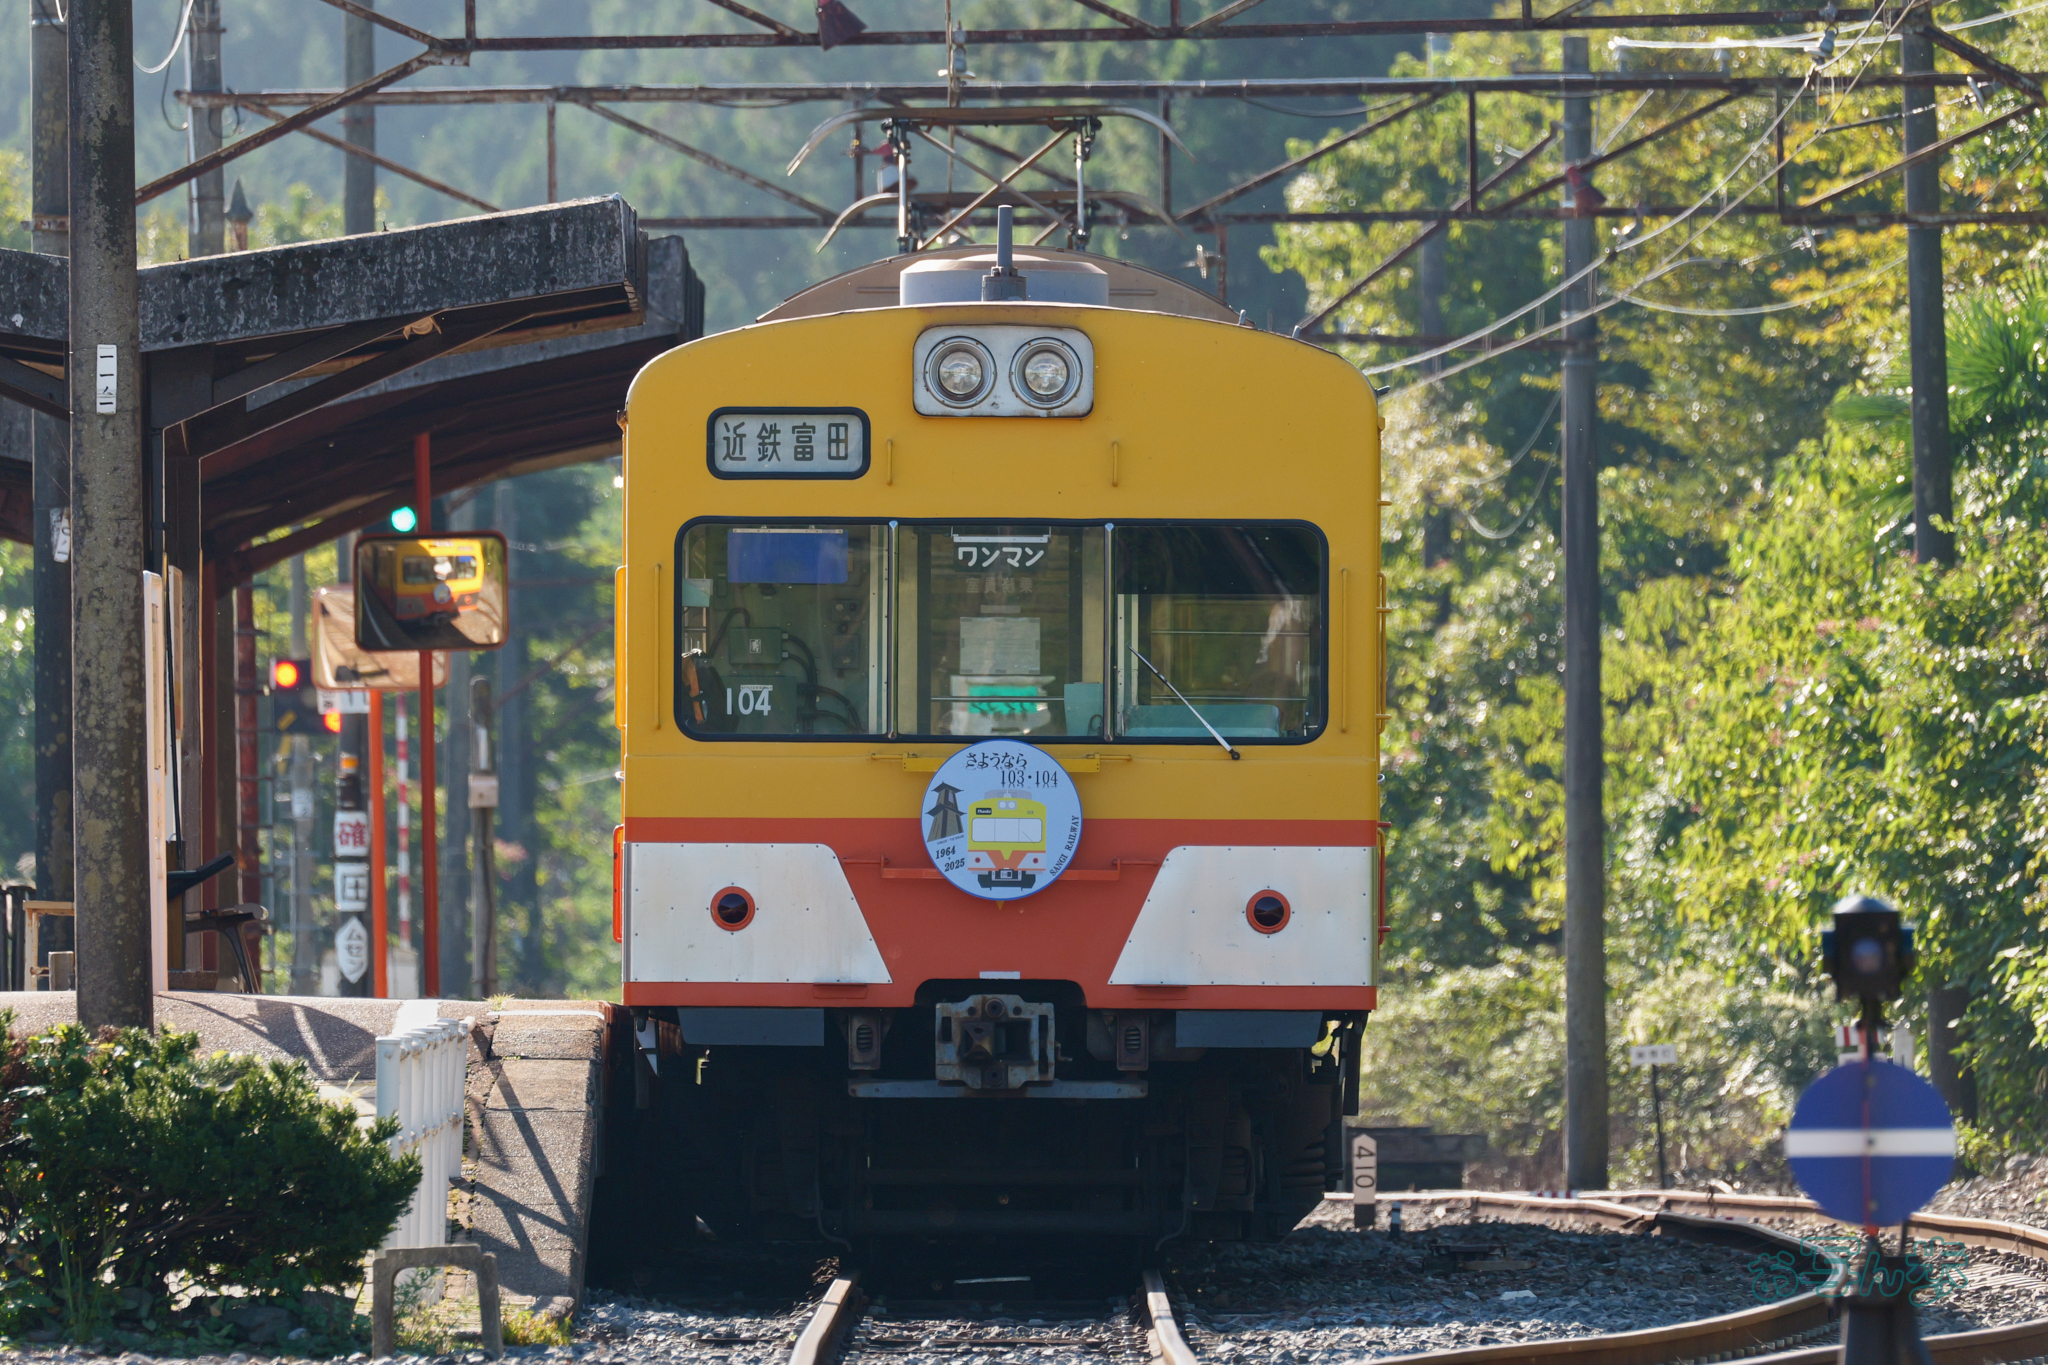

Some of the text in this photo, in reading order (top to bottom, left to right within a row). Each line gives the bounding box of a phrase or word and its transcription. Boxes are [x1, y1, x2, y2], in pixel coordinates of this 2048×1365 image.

[723, 422, 848, 461] 近鉄富田
[958, 547, 1044, 567] ワンマン
[727, 688, 771, 715] 104
[966, 752, 1027, 768] さようなら
[339, 820, 366, 847] 確
[1050, 815, 1079, 876] SANGI RAILWAY
[935, 845, 956, 860] 1964
[944, 857, 965, 872] 2025
[345, 928, 363, 976] ムセン
[1355, 1146, 1375, 1187] 410
